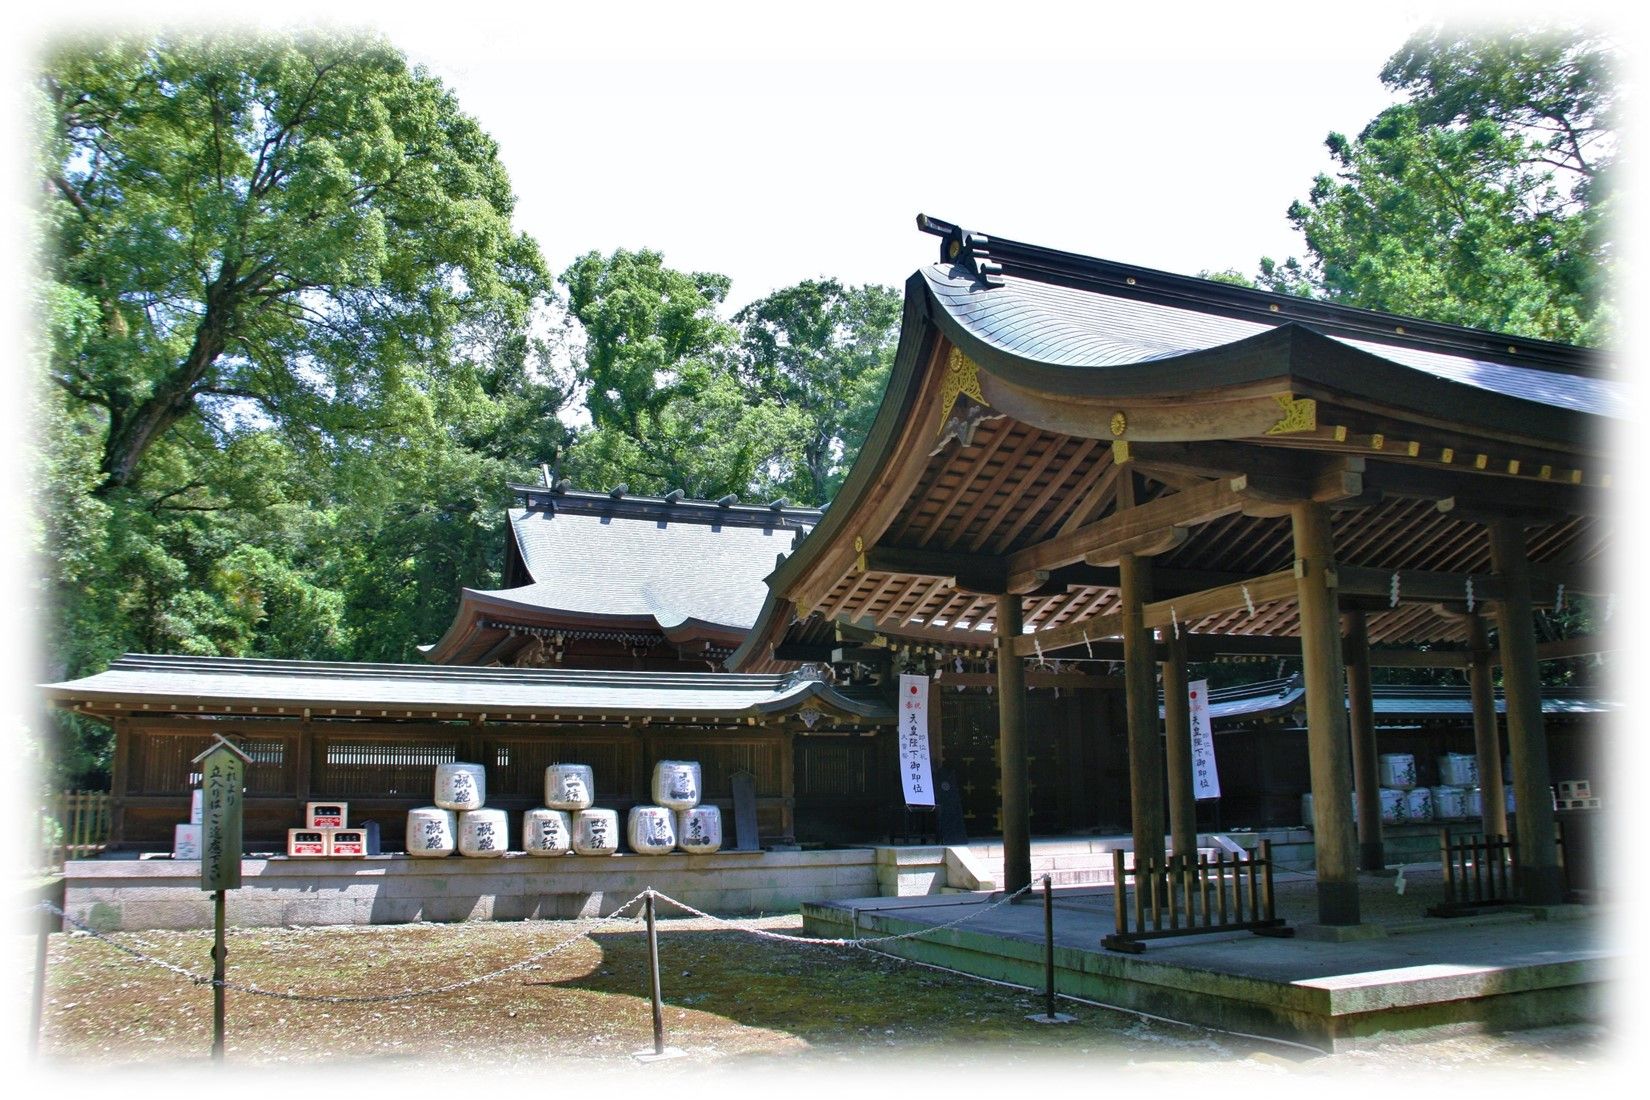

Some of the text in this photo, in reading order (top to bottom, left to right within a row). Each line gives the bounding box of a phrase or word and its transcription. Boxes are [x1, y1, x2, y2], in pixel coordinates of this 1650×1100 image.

[225, 759, 237, 807] これより
[909, 713, 923, 794] 天皇陛下御即位
